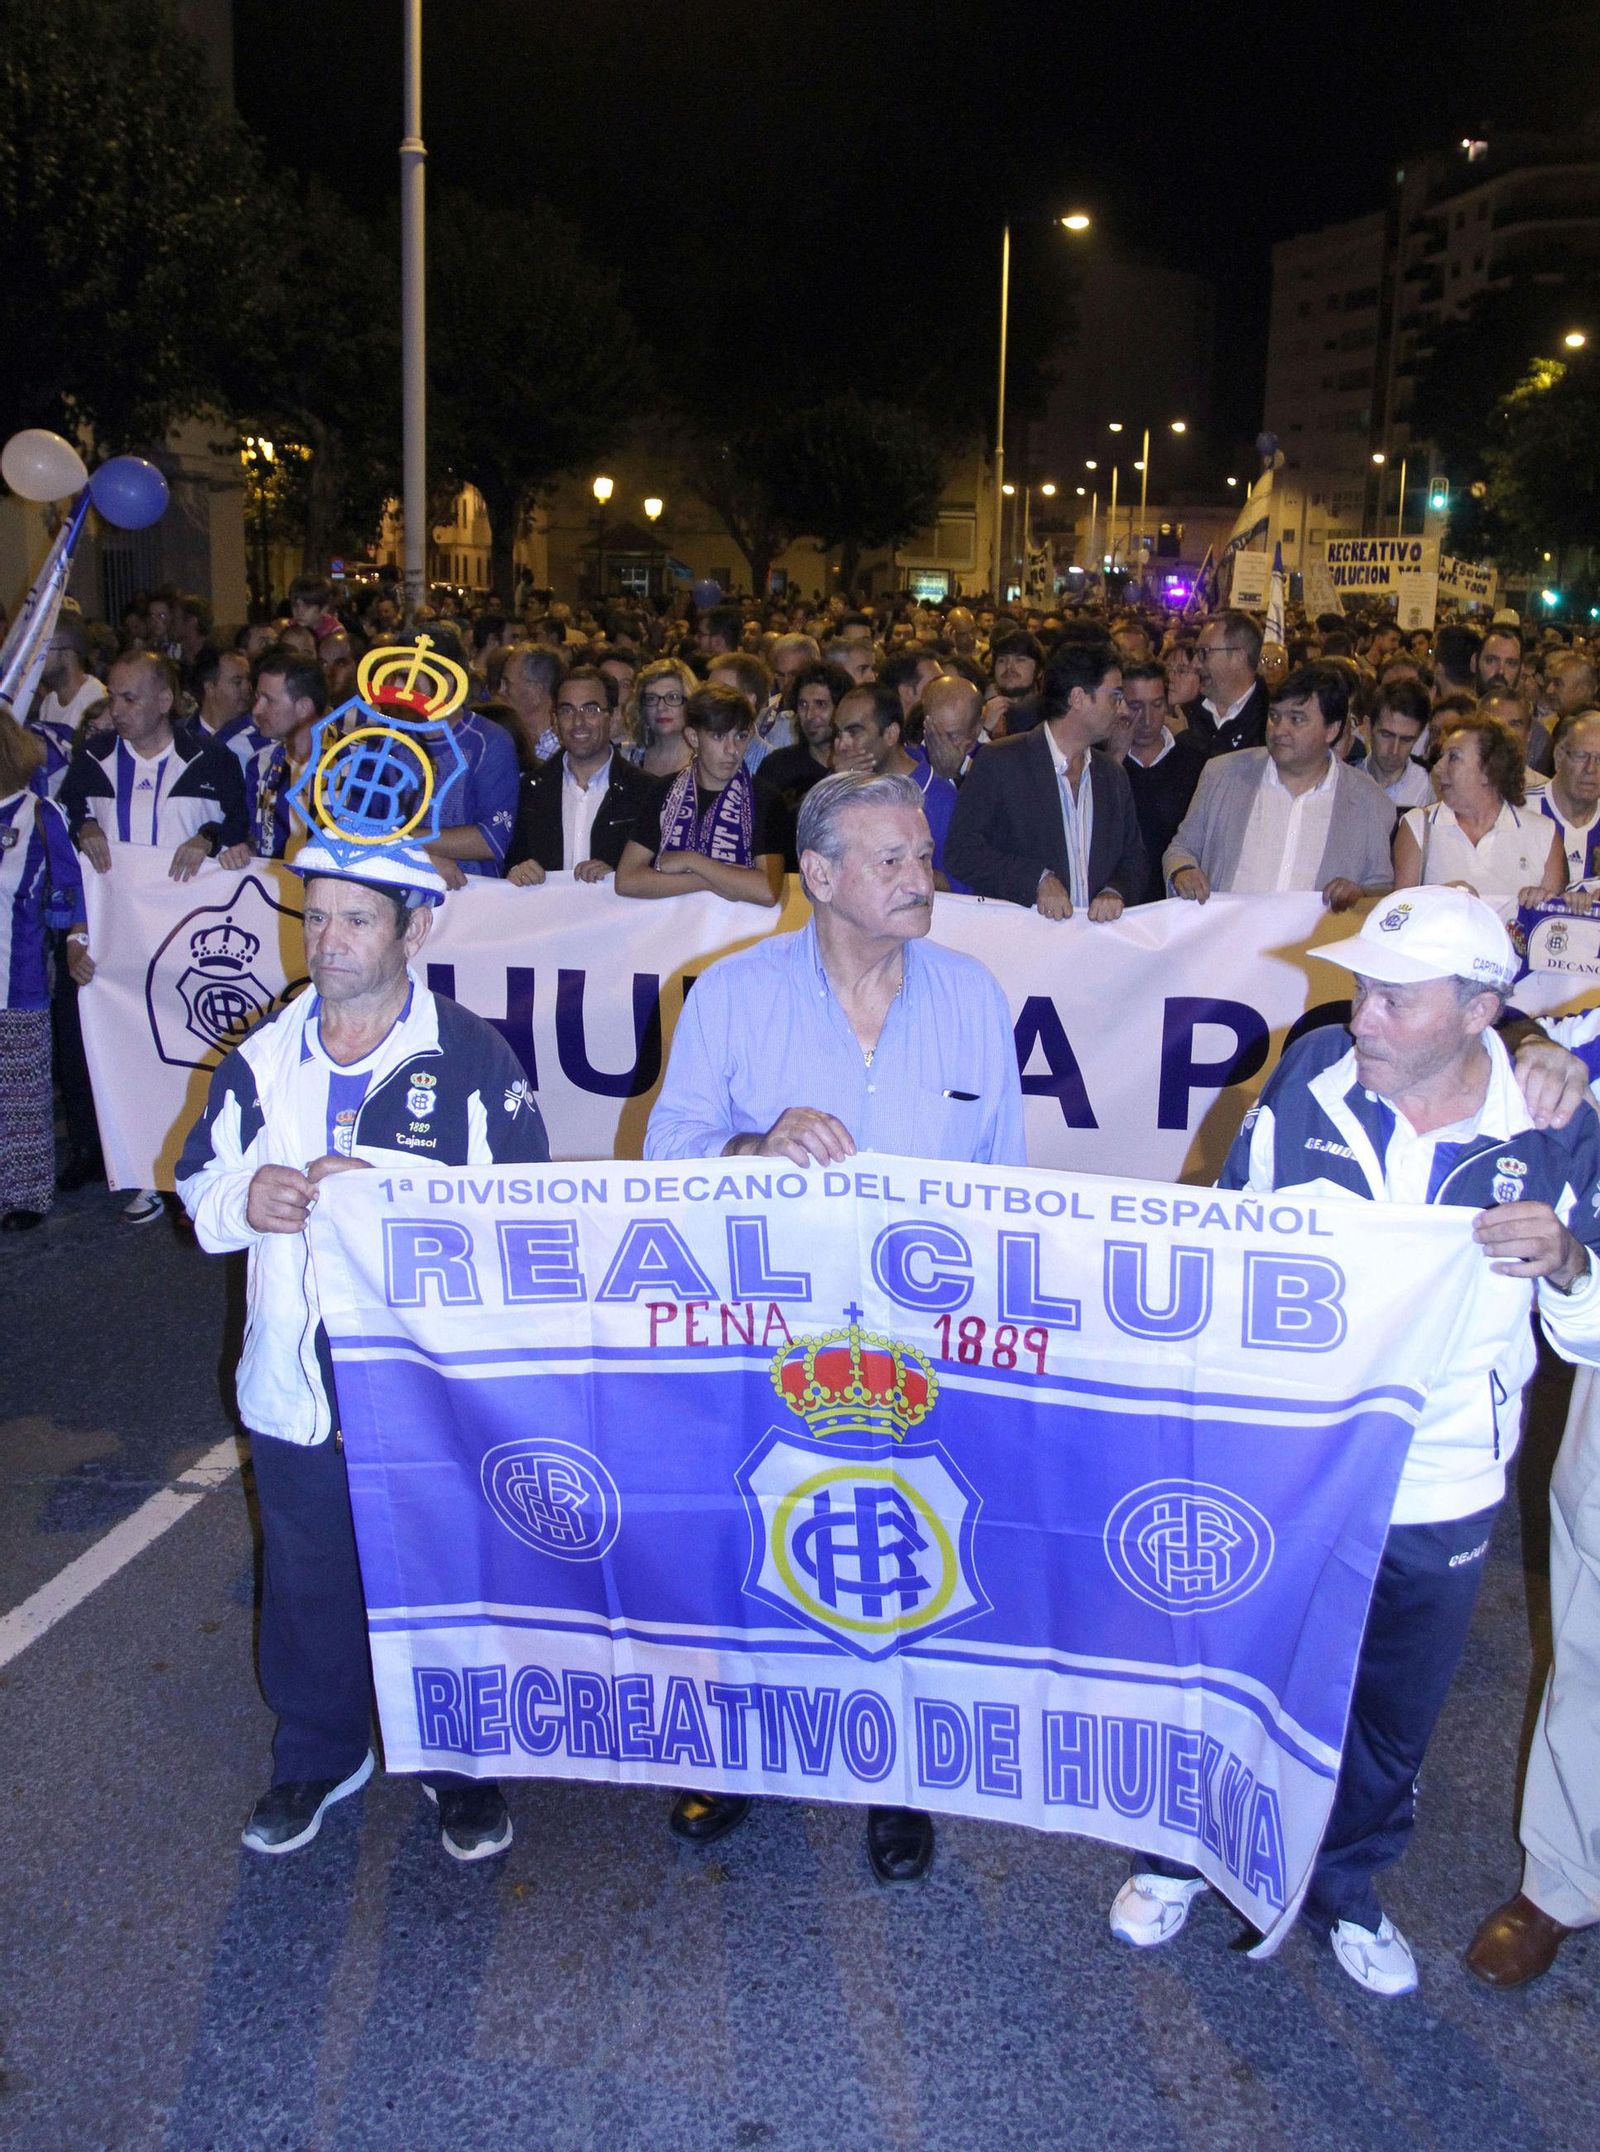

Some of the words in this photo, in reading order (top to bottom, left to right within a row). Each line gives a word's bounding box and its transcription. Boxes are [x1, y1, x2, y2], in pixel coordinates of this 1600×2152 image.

[1328, 541, 1422, 562] RECREATIVO
[395, 1132, 437, 1148] Cajasol
[409, 1121, 430, 1133] 1889
[428, 1178, 607, 1205] DIVISION
[624, 1173, 808, 1203] DECANO
[824, 1173, 905, 1202] DEL
[919, 1179, 1095, 1220] FUTBOL
[1110, 1194, 1335, 1236] ESPAÑOL
[381, 1215, 813, 1308] REAL
[870, 1219, 1348, 1354] CLUB
[933, 1313, 1050, 1376] 1889
[412, 1664, 897, 1783] RECREATIVO
[914, 1697, 1022, 1800] DE
[1042, 1709, 1287, 1912] HUELVA
